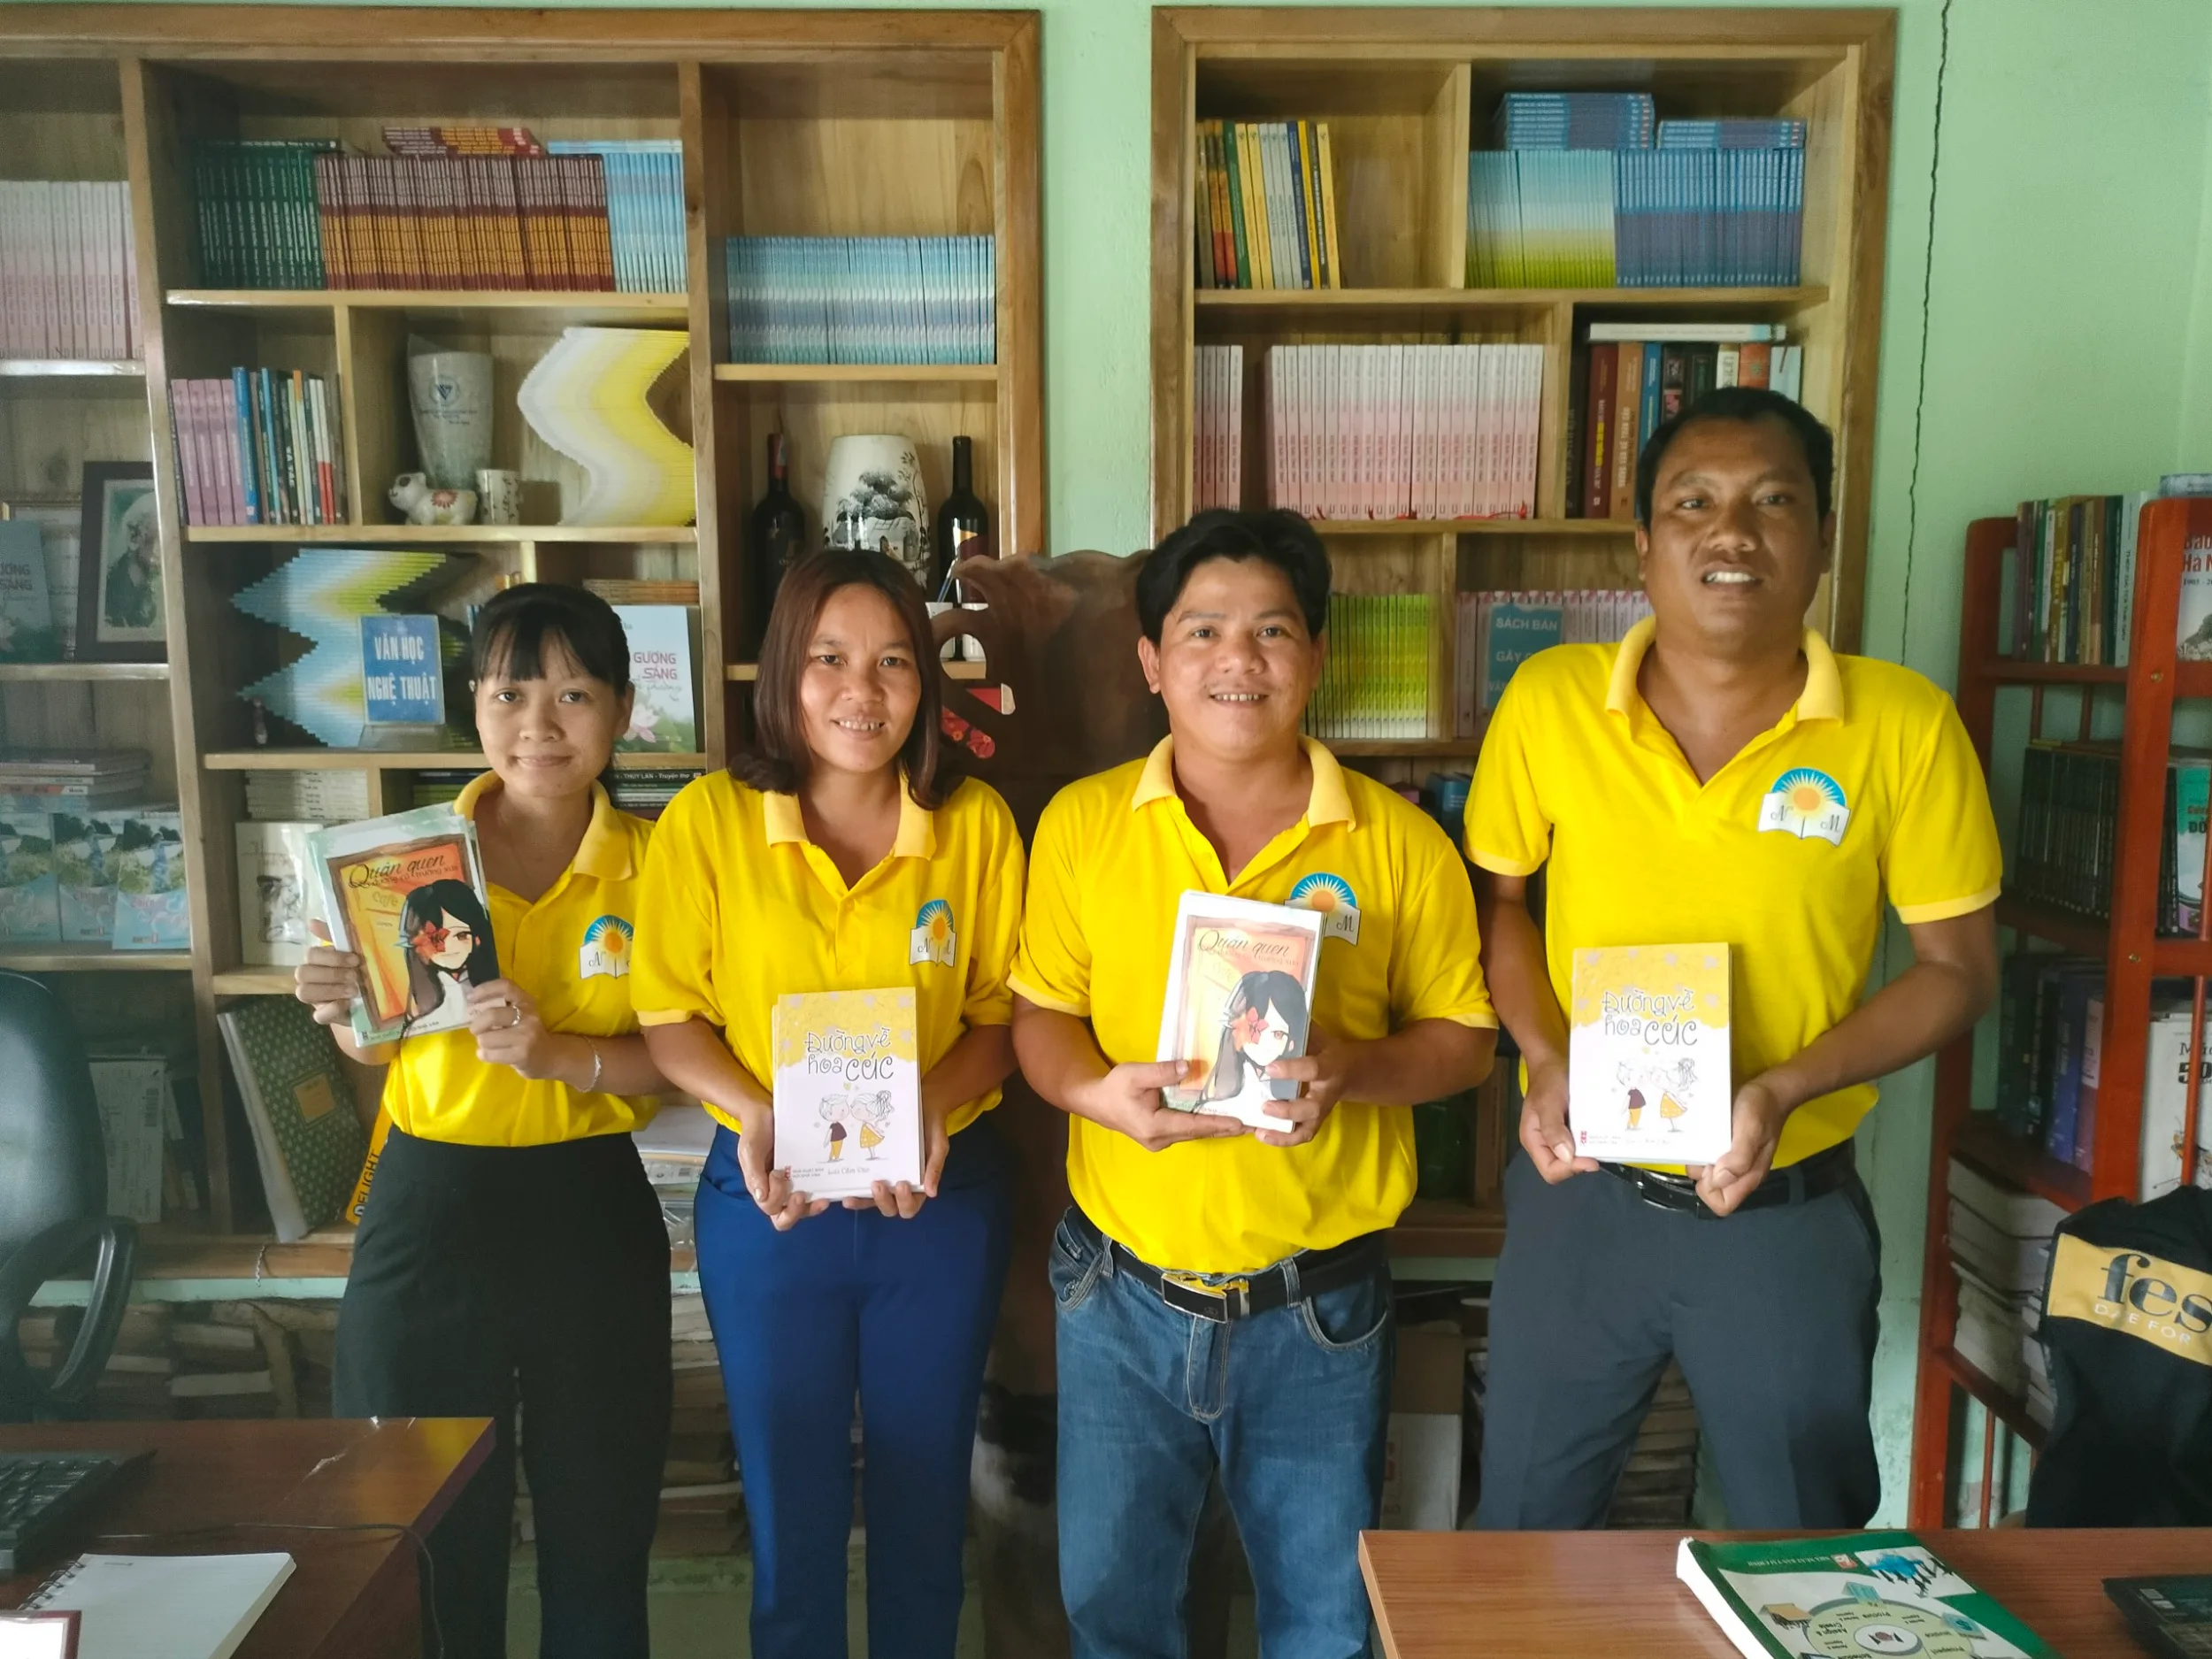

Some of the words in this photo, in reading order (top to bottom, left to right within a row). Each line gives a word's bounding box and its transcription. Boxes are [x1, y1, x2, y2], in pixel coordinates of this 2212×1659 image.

[1495, 615, 1529, 629] SÁCH
[374, 633, 399, 660] VĂN
[401, 636, 425, 664] HỌC
[642, 666, 677, 680] SÁNG
[348, 861, 401, 888] Quán
[406, 854, 445, 872] quen
[1198, 929, 1248, 956] Quán
[1253, 940, 1289, 961] quen
[1604, 1014, 1641, 1036] hoa
[1644, 1015, 1698, 1046] cúc
[808, 1053, 842, 1074] hoa
[845, 1051, 895, 1081] cúc
[2098, 1254, 2212, 1333] fes
[2148, 1320, 2192, 1346] FOR
